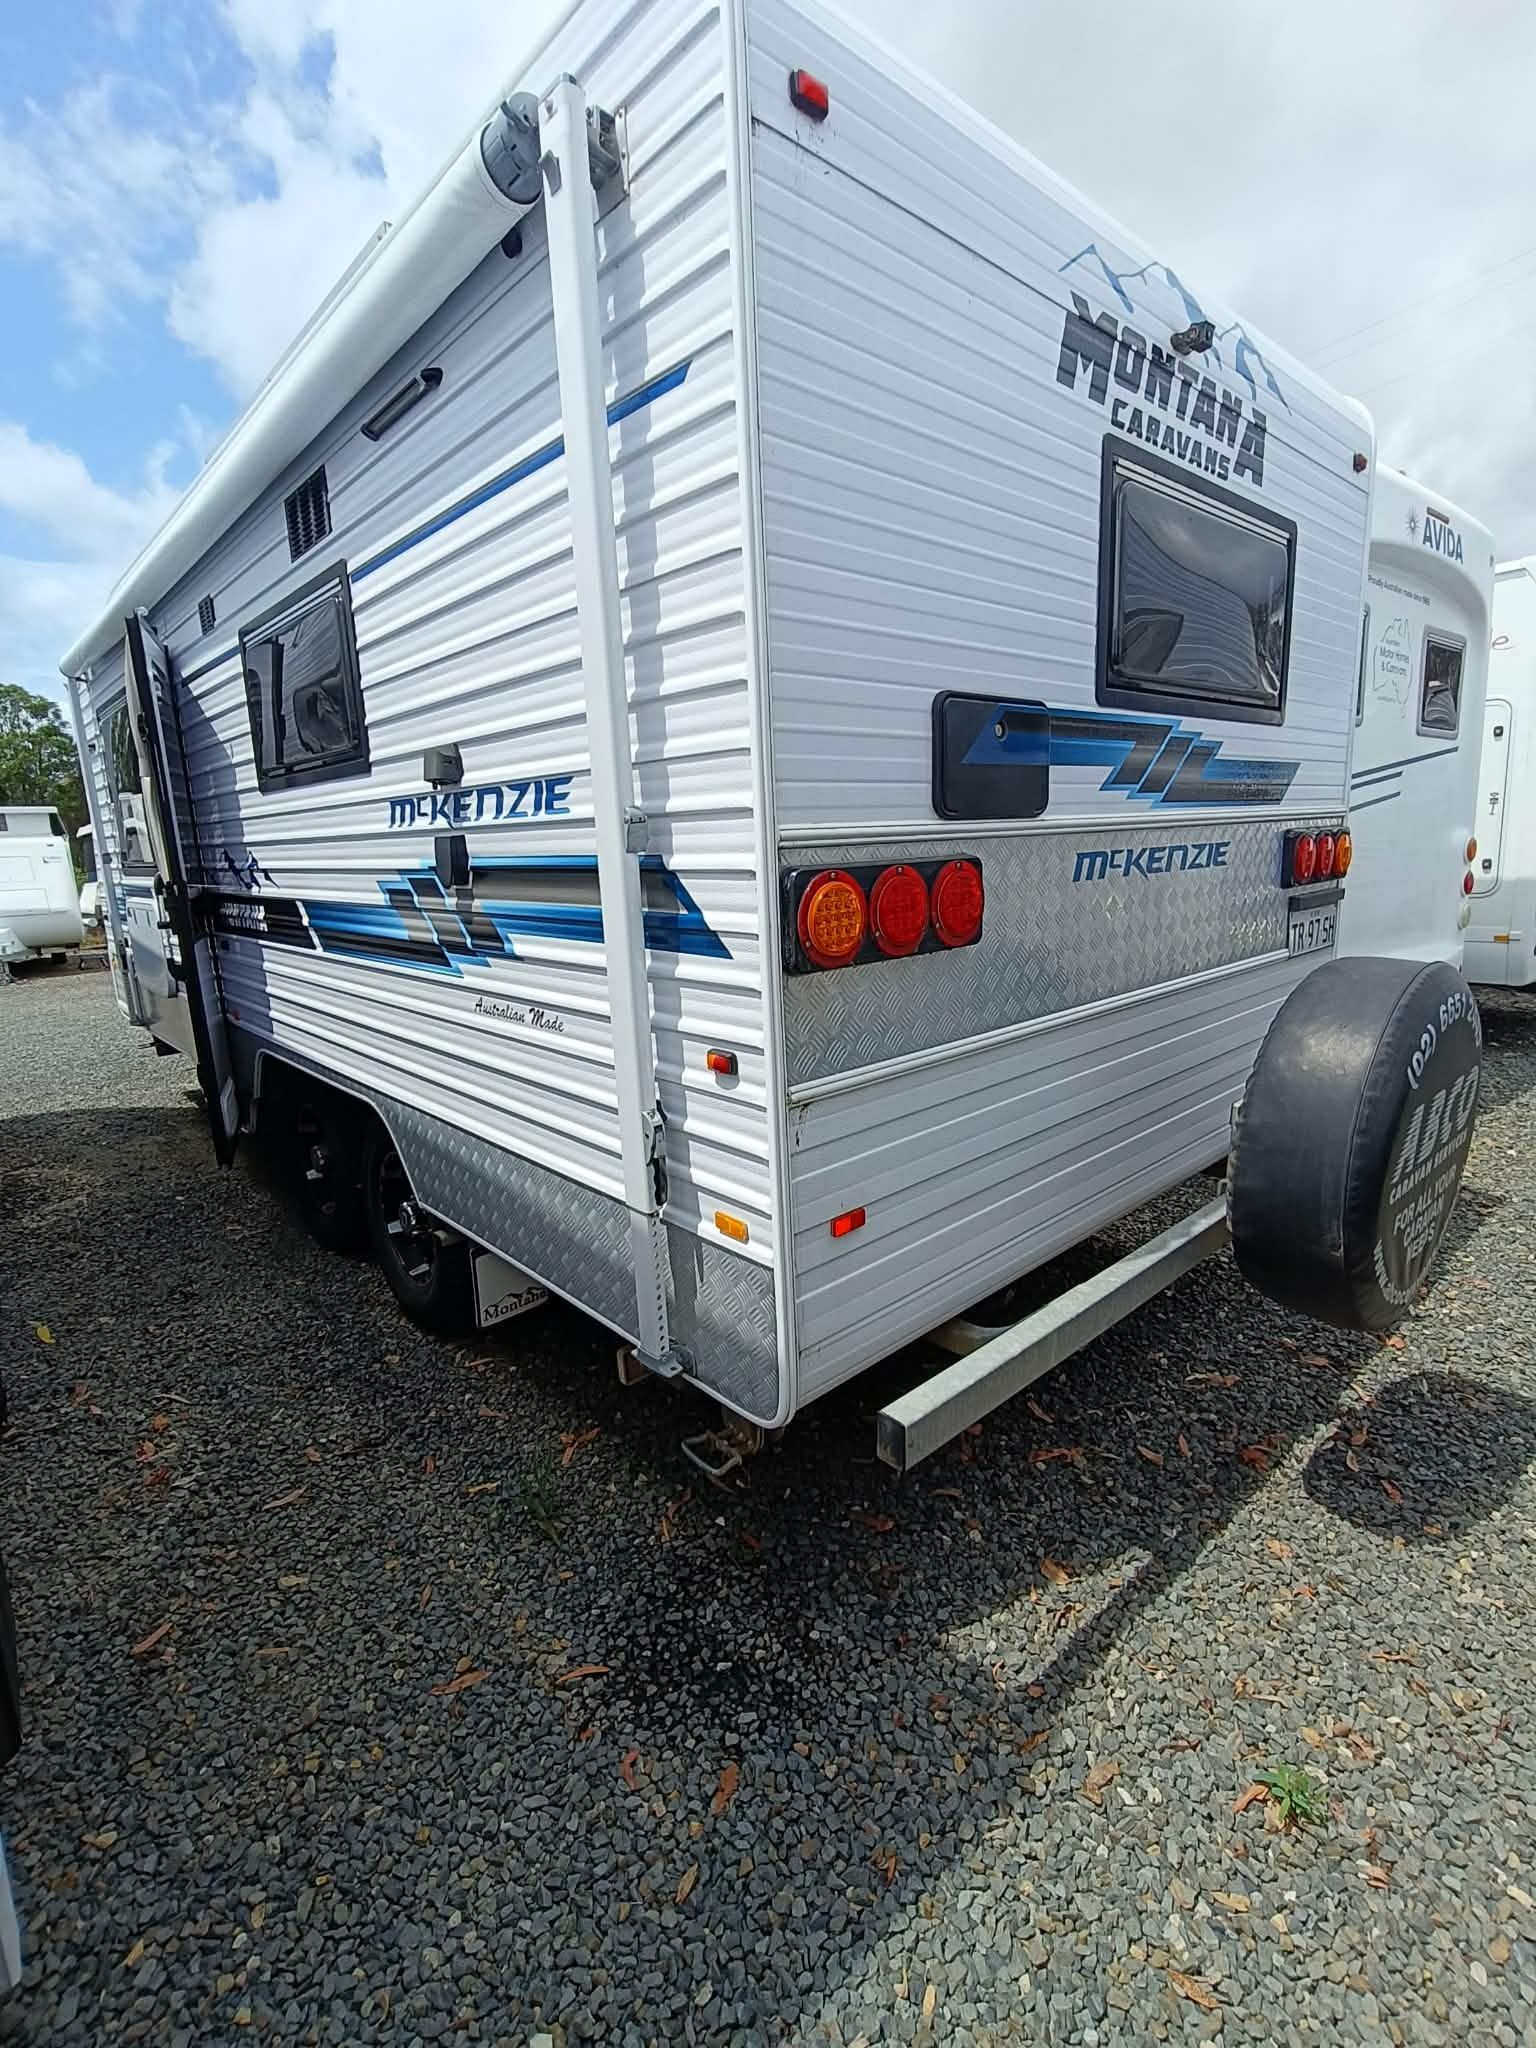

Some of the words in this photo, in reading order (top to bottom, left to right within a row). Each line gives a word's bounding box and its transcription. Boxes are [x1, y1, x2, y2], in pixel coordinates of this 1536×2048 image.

[1056, 289, 1267, 488] MONTANA
[1110, 397, 1231, 481] CARAVANS
[1423, 516, 1464, 564] AVIDA
[474, 996, 525, 1023] Australian
[528, 1008, 565, 1033] Made
[1407, 1024, 1437, 1090] (02)
[1393, 1201, 1416, 1236] FOR
